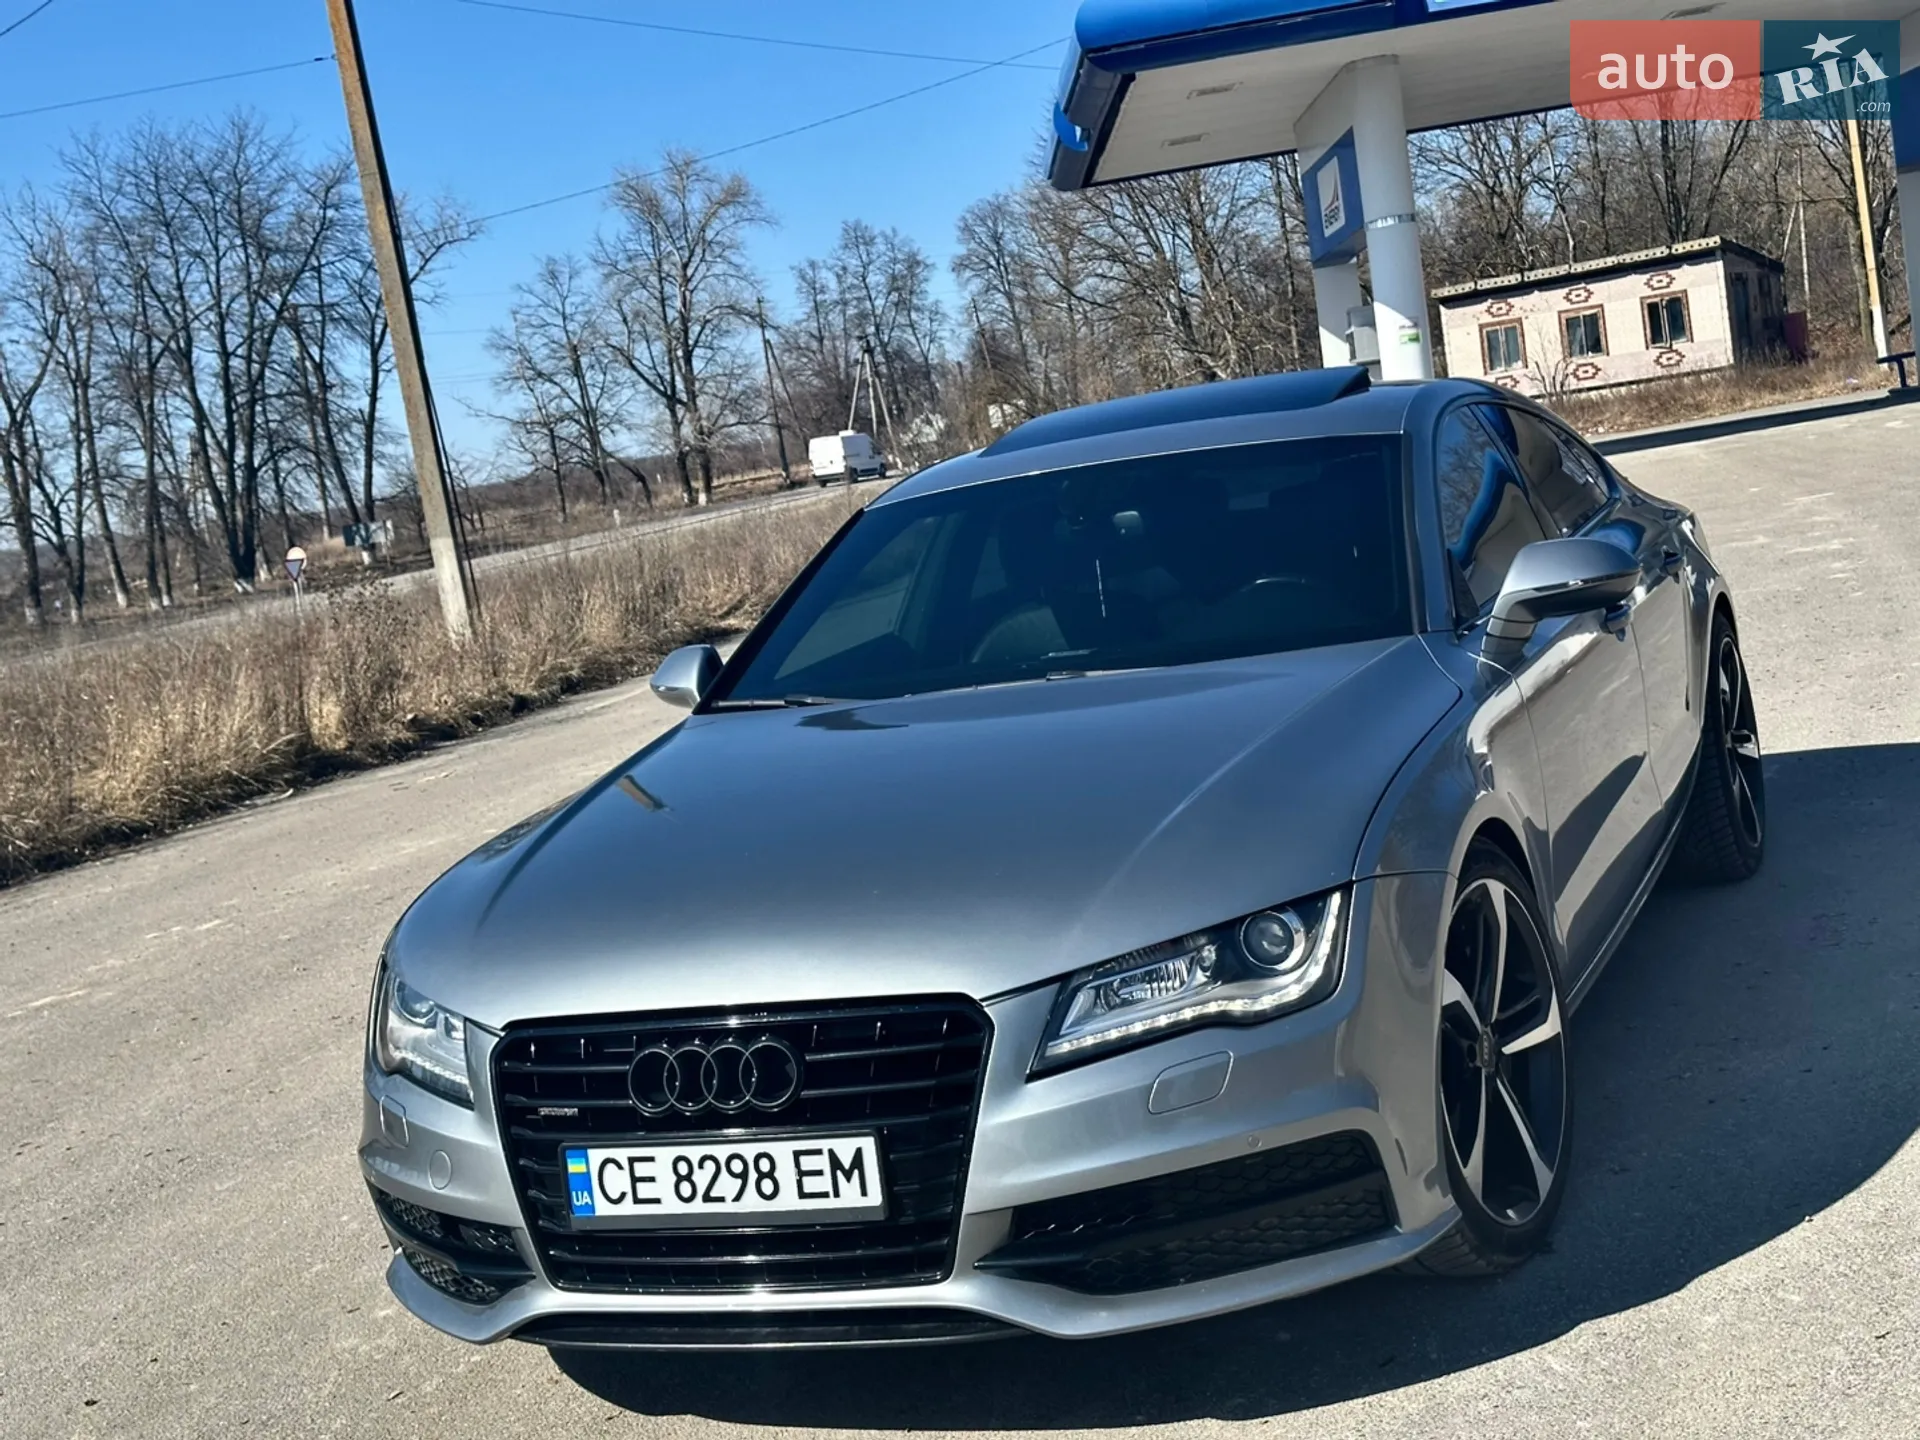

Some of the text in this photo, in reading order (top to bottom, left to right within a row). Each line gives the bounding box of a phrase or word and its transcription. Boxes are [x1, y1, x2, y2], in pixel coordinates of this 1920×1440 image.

[597, 1147, 868, 1205] CE 8298 EM
[572, 1190, 592, 1206] UA
